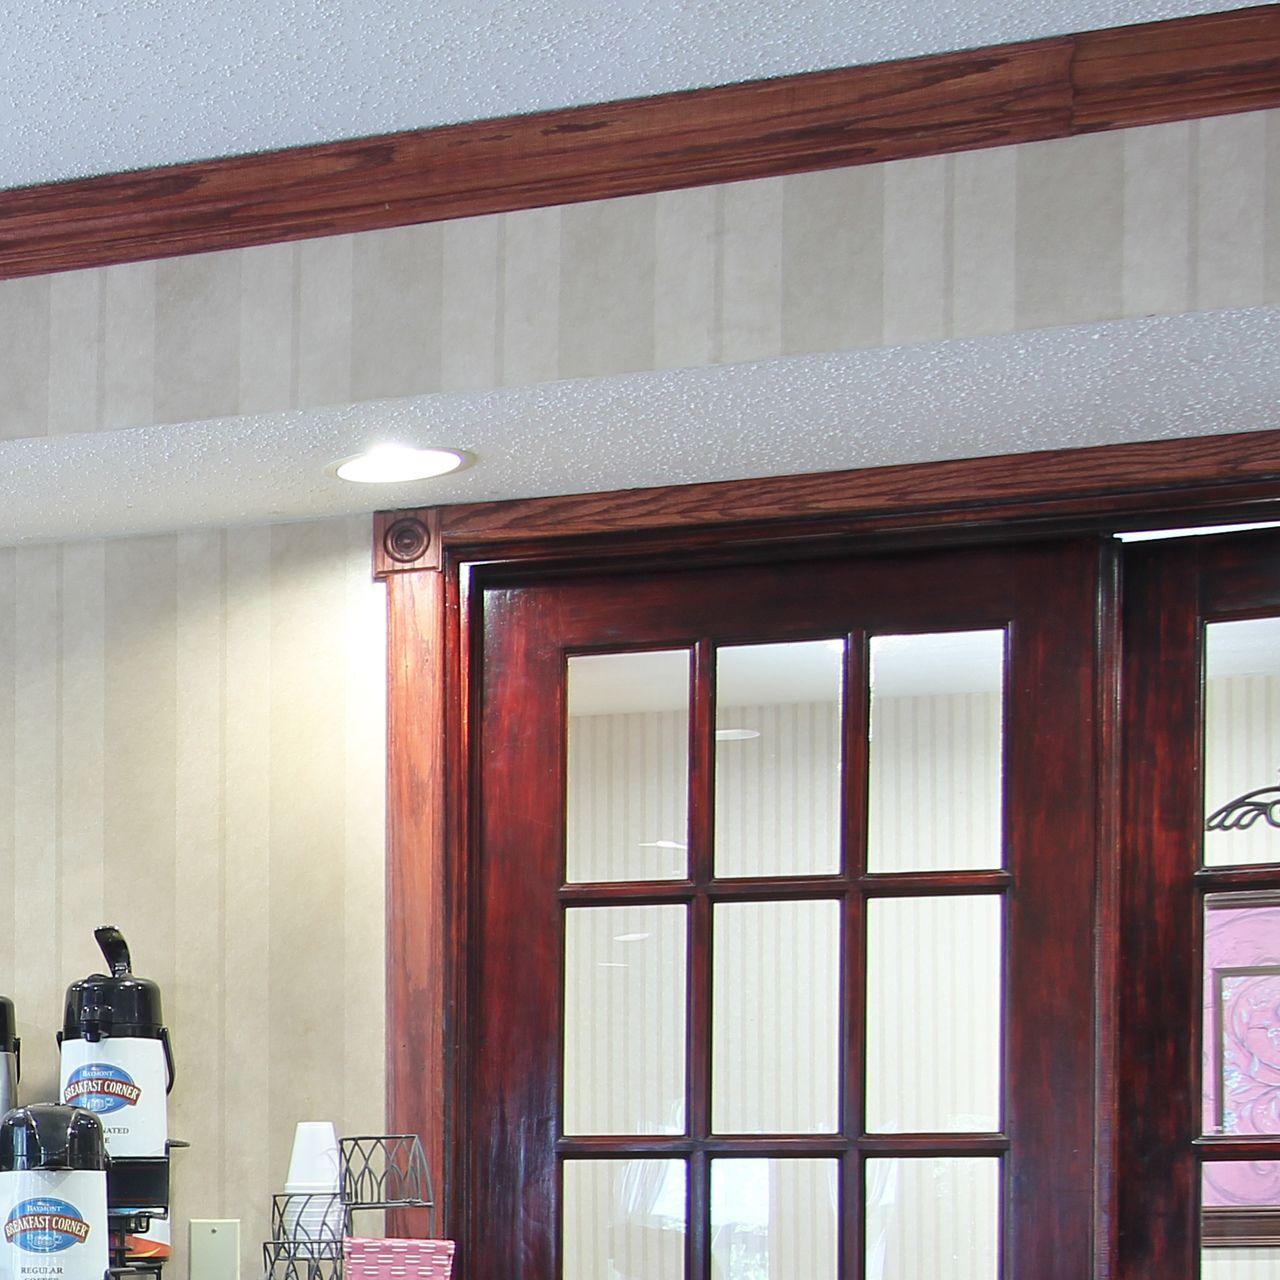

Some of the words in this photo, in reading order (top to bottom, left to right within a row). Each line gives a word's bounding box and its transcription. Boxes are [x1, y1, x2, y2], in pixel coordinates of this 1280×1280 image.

[65, 1080, 103, 1101] BREAKFAST
[104, 1080, 139, 1100] CORNER
[5, 1215, 50, 1237] BREAKFAST
[52, 1216, 87, 1238] CORNER
[20, 1267, 64, 1275] REGULAR
